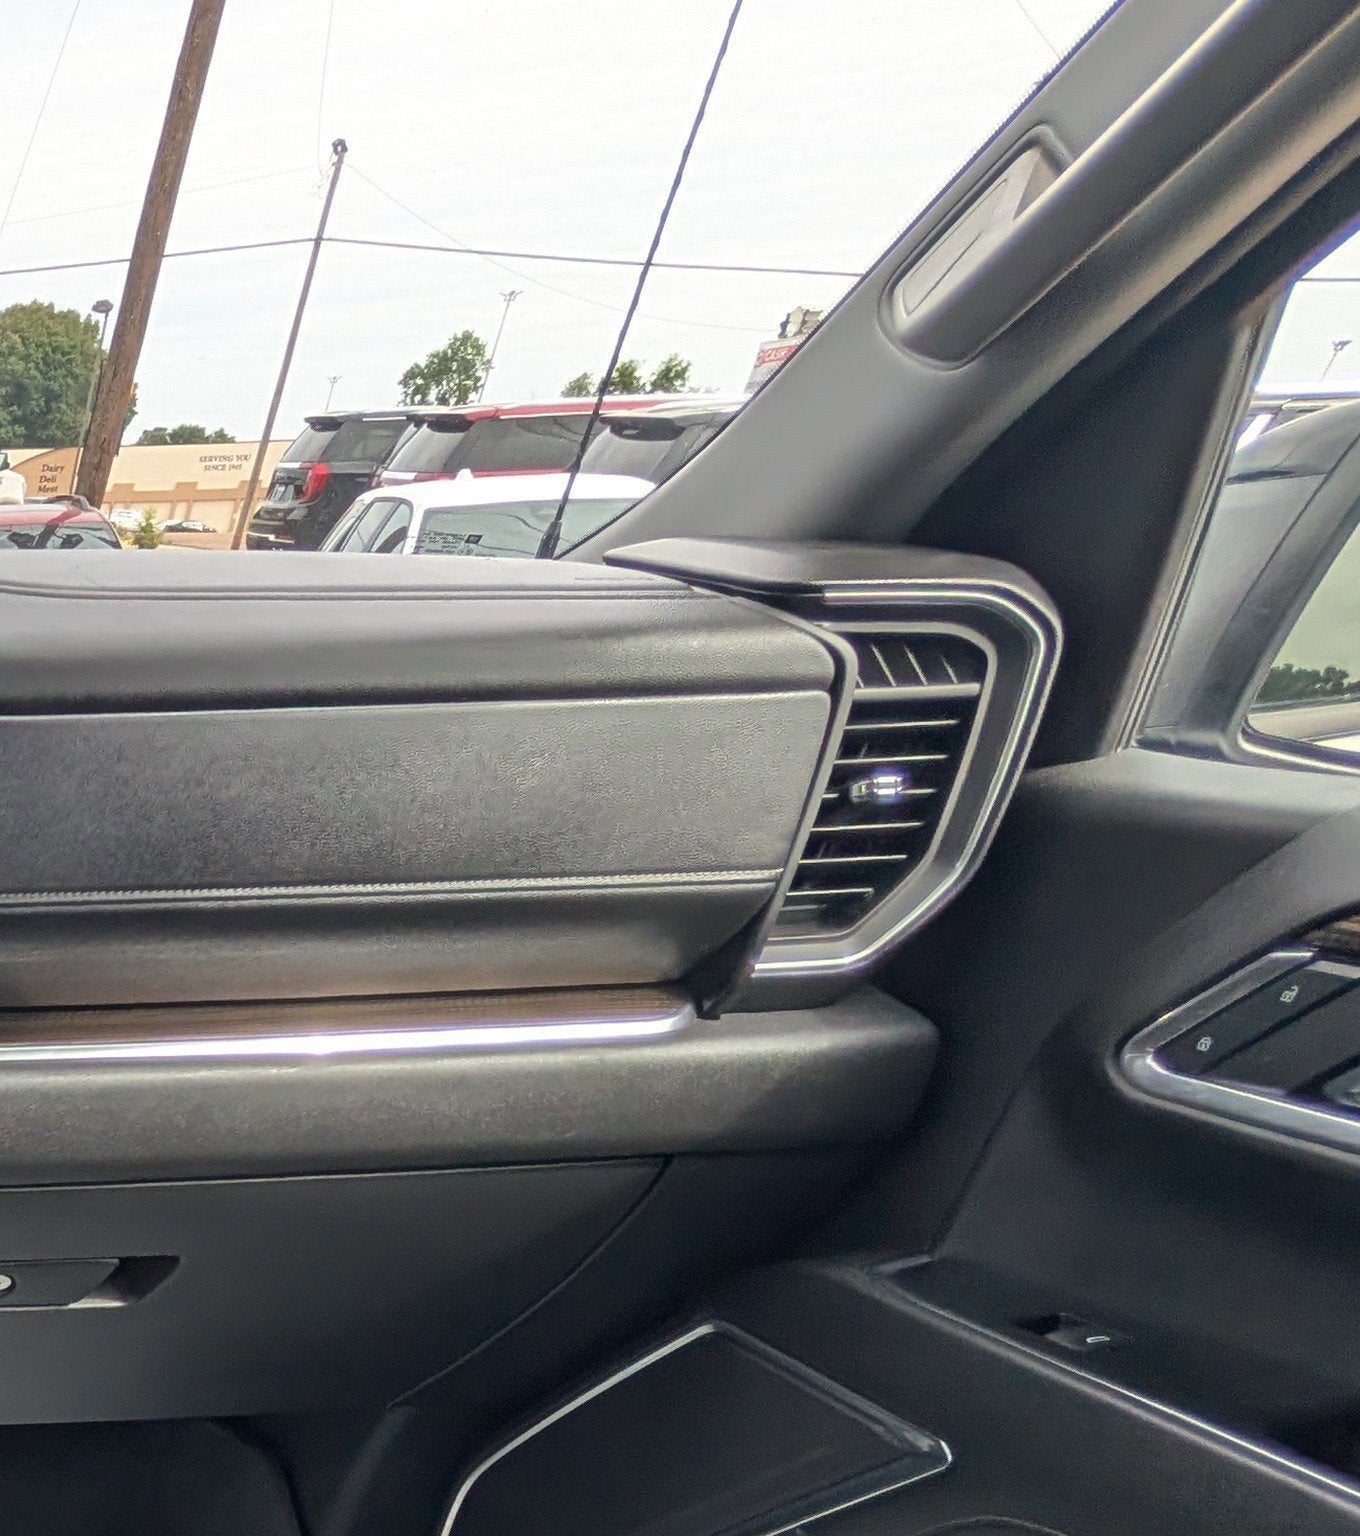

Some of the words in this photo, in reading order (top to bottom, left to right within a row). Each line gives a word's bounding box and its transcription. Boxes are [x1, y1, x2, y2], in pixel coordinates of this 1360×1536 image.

[199, 454, 234, 463] SERVING
[235, 453, 252, 462] YOU
[41, 463, 65, 475] Dairy
[203, 463, 227, 471] SINCE
[39, 474, 58, 484] Deli
